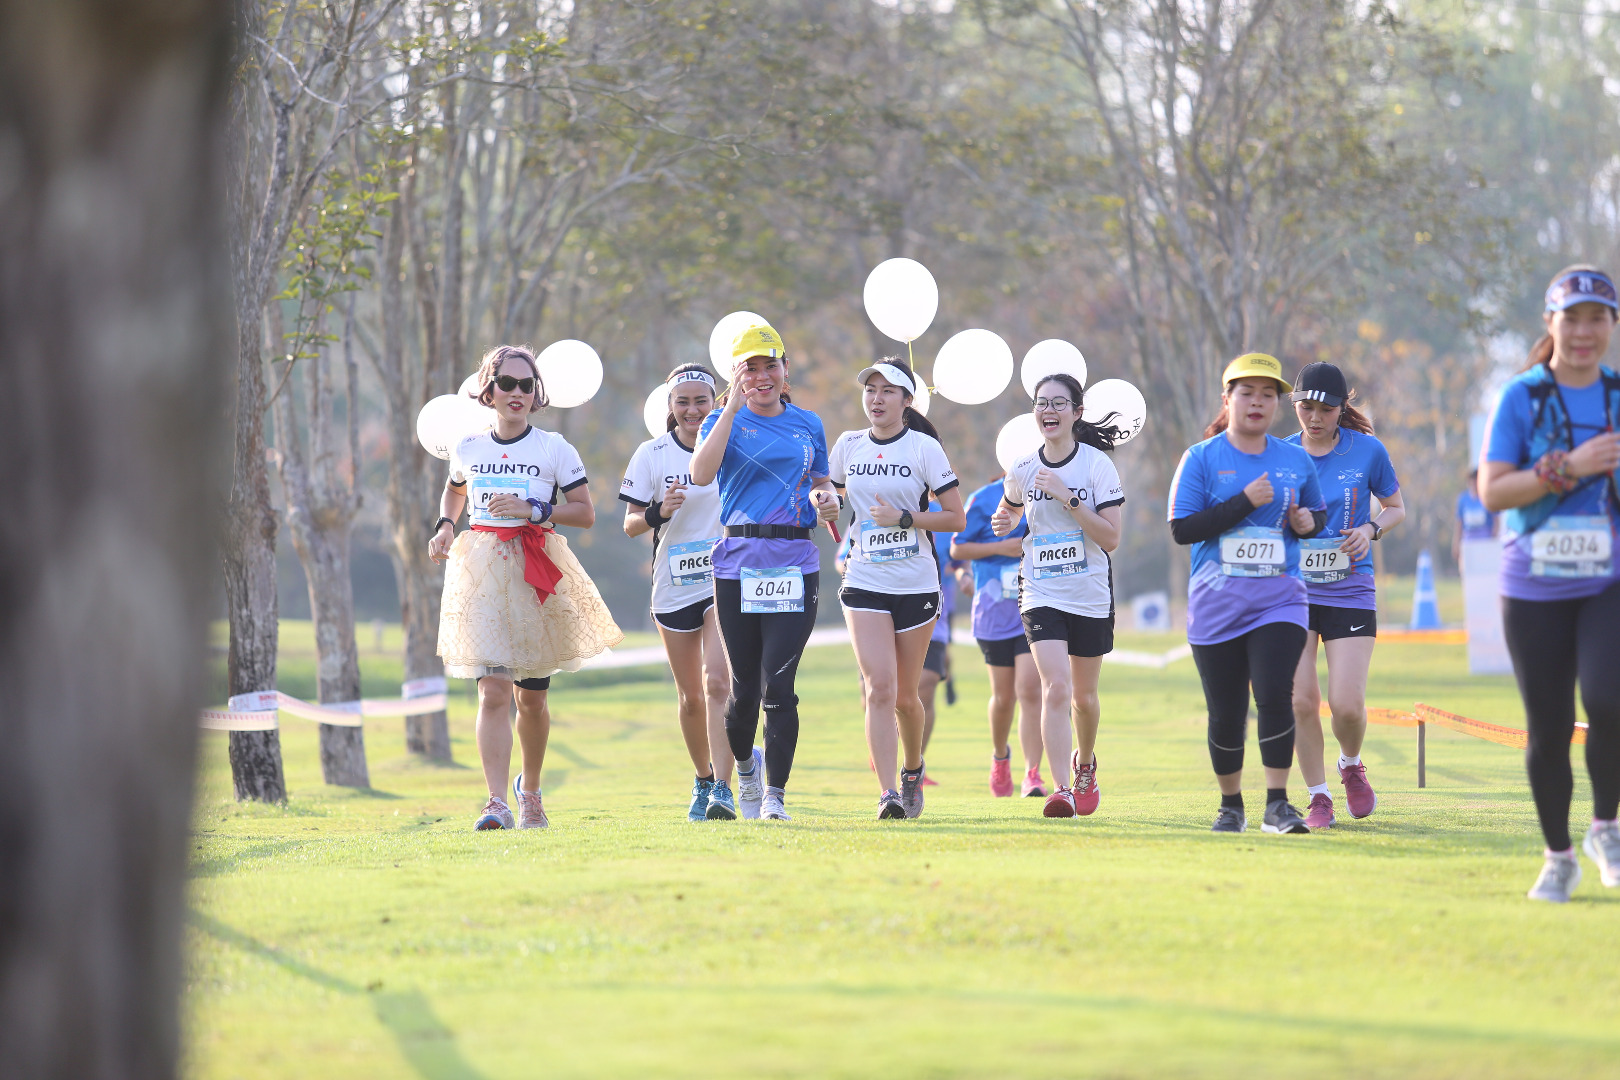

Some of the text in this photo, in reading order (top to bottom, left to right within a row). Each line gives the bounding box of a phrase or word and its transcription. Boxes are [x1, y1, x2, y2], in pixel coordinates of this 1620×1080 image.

[1250, 359, 1277, 370] SEIKO
[677, 371, 706, 382] FILA
[470, 463, 540, 477] SUUNTO
[847, 464, 912, 478] SUUNTO
[664, 474, 697, 489] SUU
[869, 531, 908, 546] PACER
[1546, 535, 1598, 556] 6034
[1040, 546, 1077, 561] PACER
[1236, 543, 1274, 559] 6071
[680, 555, 713, 570] PACE
[1305, 552, 1337, 568] 6119
[755, 581, 792, 596] 6041
[790, 603, 797, 611] 16
